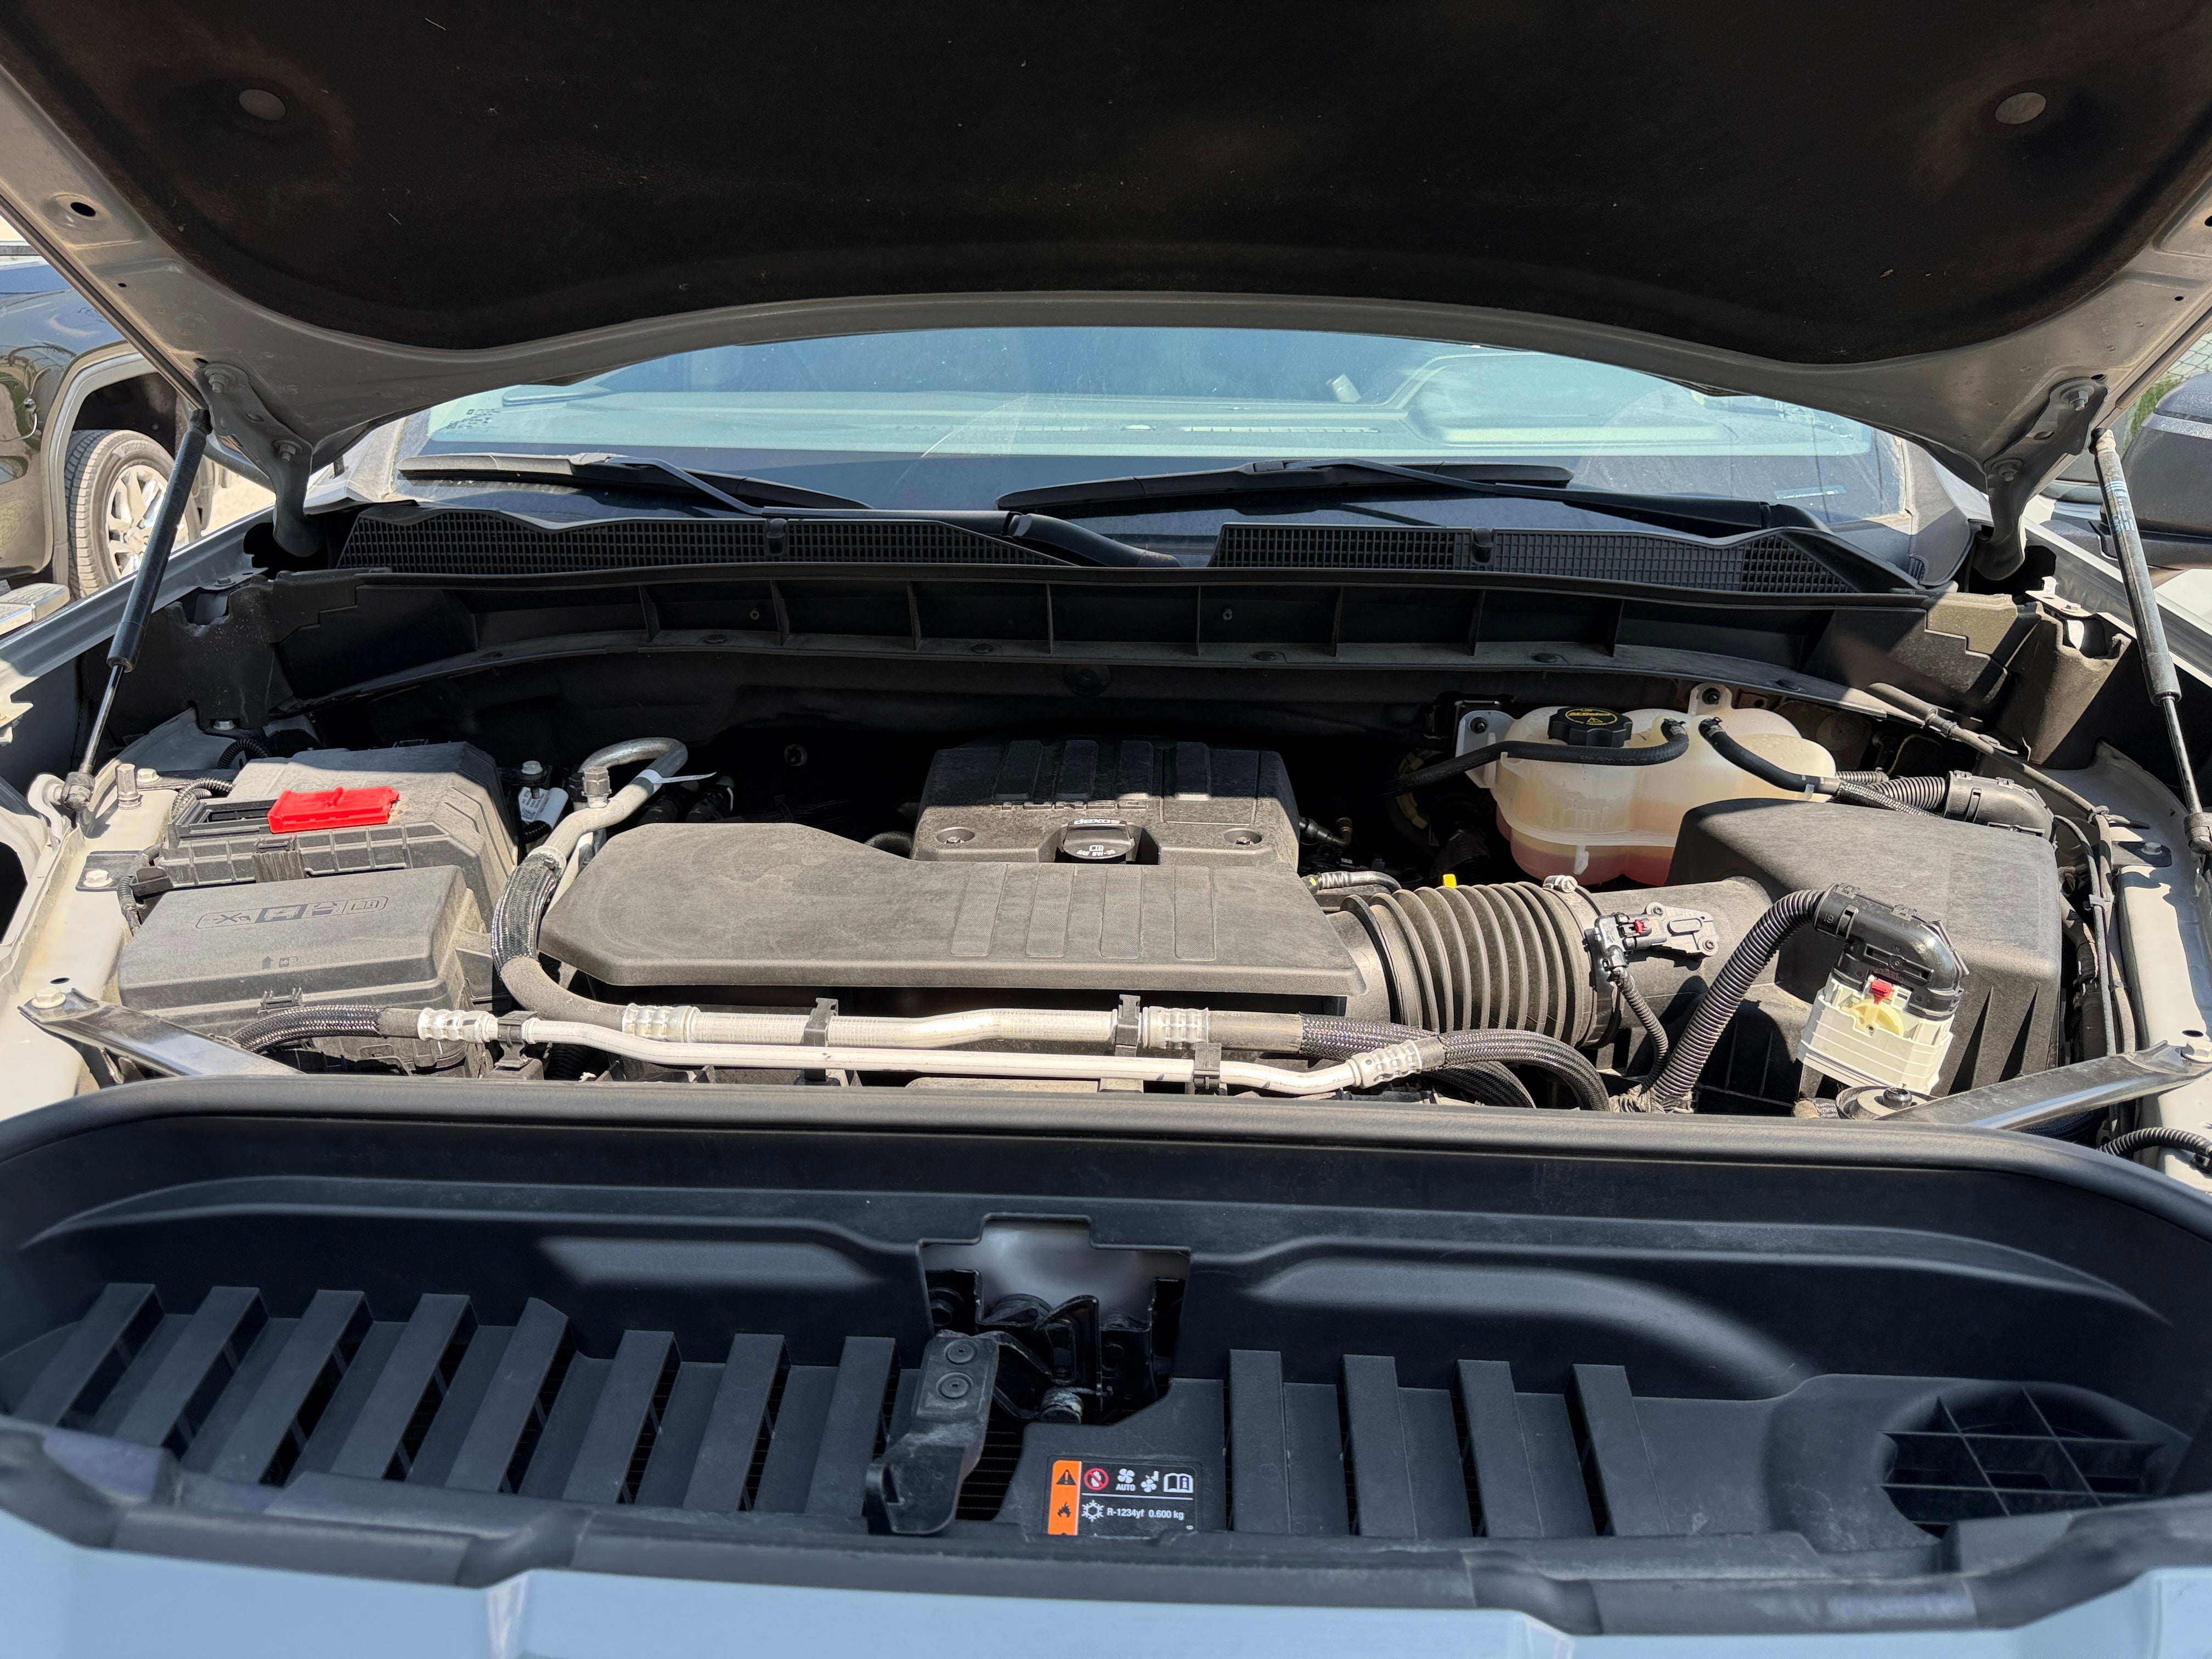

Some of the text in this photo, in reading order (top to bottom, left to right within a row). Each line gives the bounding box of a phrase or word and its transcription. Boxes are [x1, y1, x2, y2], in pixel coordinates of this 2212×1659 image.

[1115, 1483, 1136, 1492] AUTO
[1107, 1507, 1184, 1521] R-1234yf 0.600 kg
